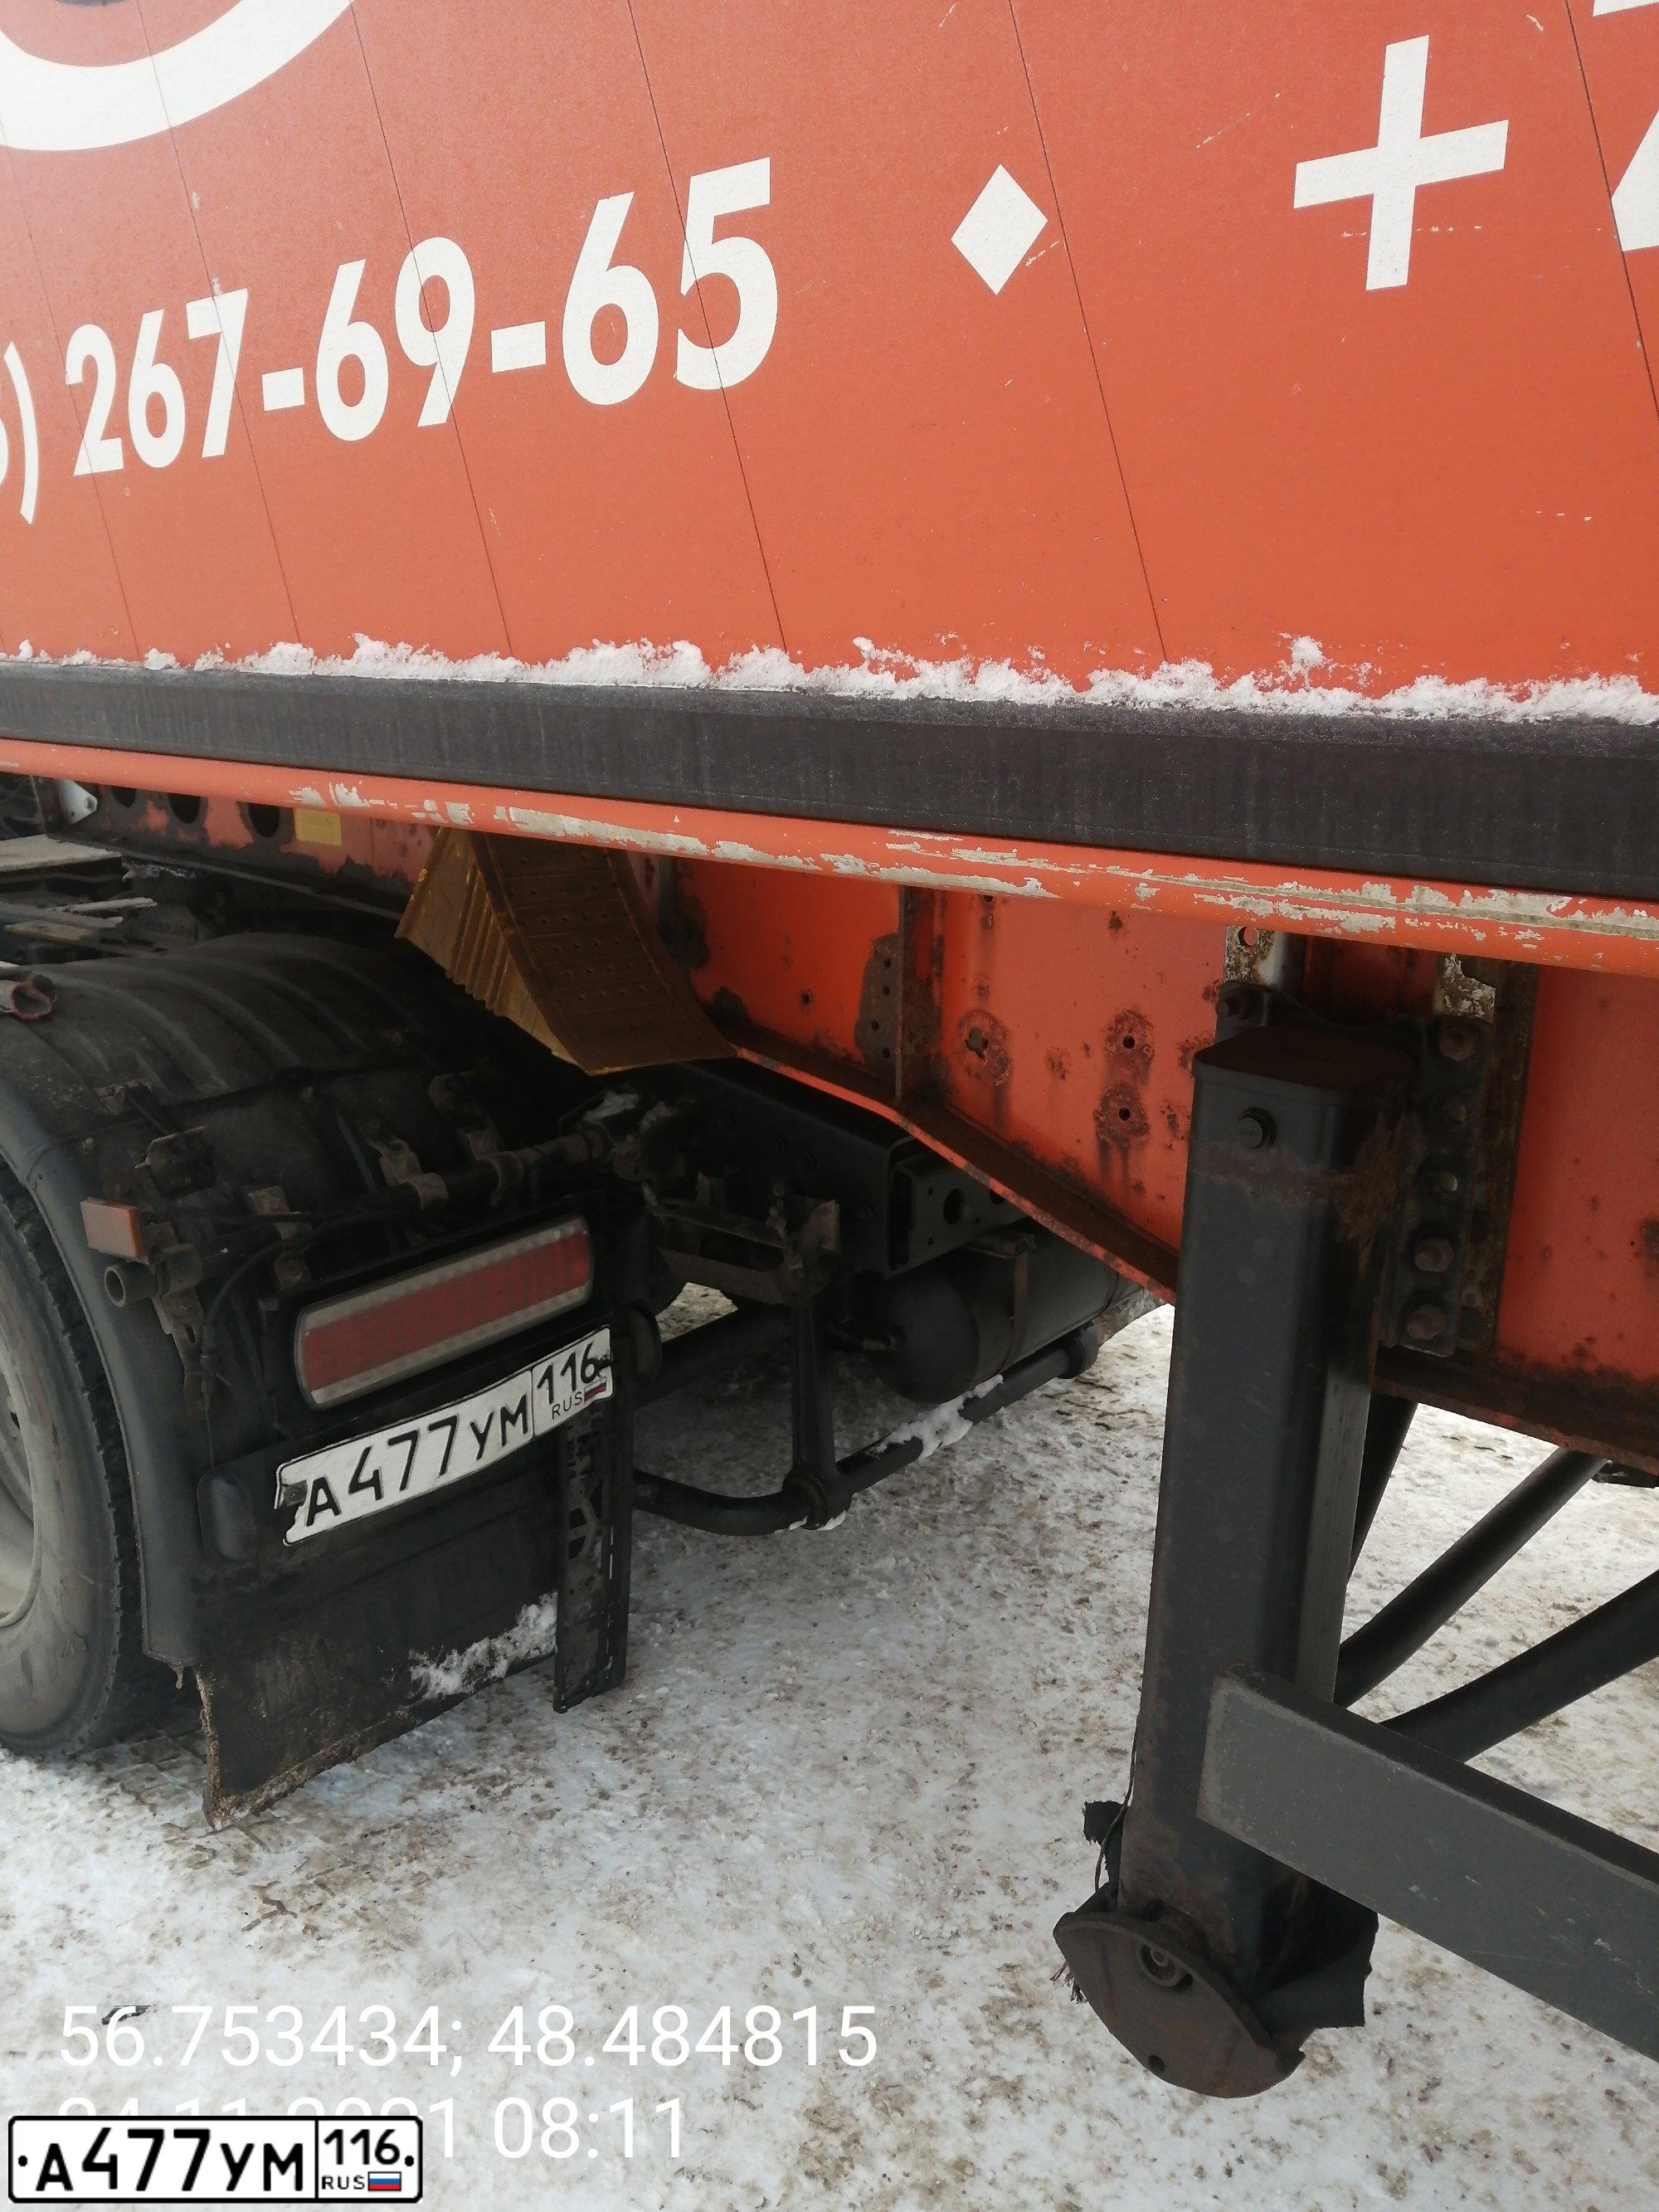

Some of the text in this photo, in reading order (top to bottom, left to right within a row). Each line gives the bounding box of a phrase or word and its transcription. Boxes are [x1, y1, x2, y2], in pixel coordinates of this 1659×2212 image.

[65, 156, 778, 476] 267-69-65
[306, 1341, 599, 1527] А477УМ 116
[552, 1391, 583, 1420] RUS
